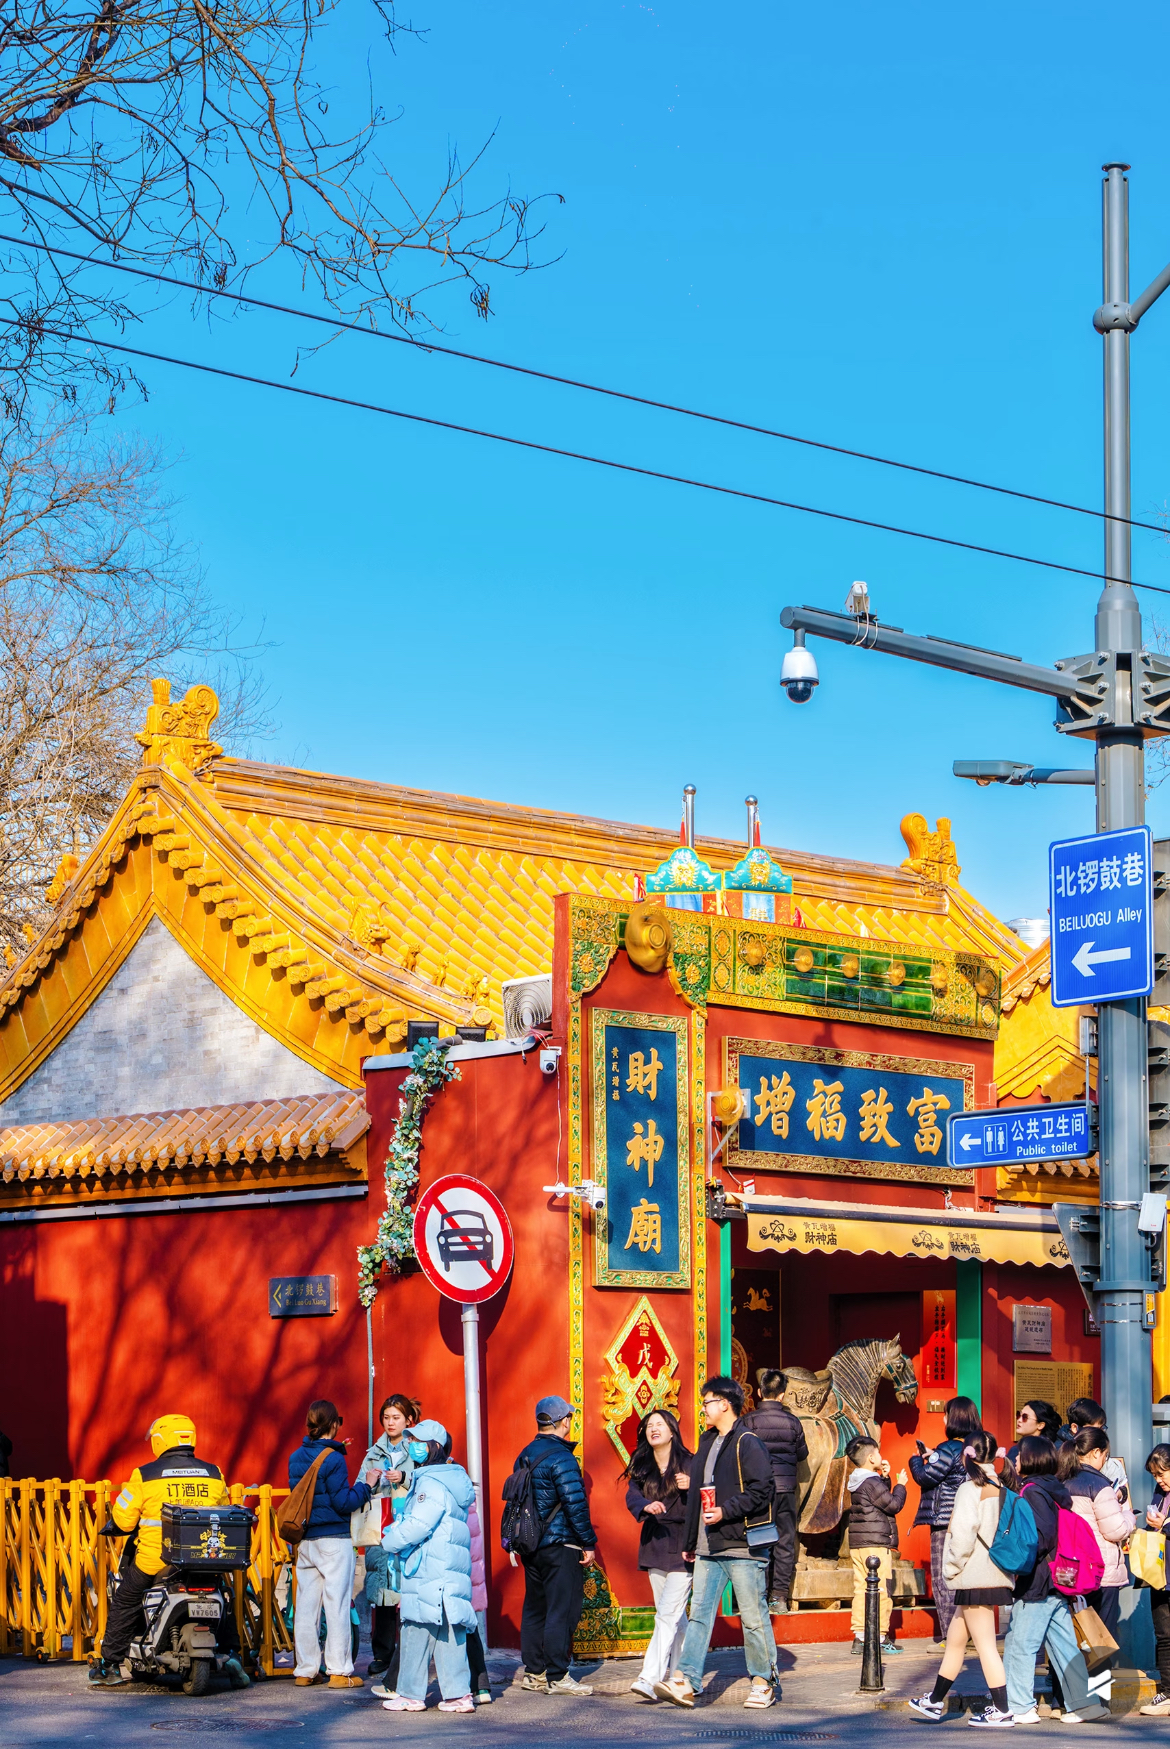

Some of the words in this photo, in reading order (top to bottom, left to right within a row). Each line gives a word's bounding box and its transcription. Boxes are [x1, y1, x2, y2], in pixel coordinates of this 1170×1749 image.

[1056, 852, 1144, 898] 北锣鼓巷
[1059, 910, 1111, 932] BEILUOGU
[1117, 907, 1142, 923] Alley
[754, 1070, 951, 1156] 增福致富
[1011, 1113, 1085, 1141] 公共卫生间
[624, 1047, 664, 1254] 財神廟
[1016, 1144, 1046, 1156] Public
[1051, 1142, 1078, 1153] toilet
[166, 1483, 209, 1498] 订酒店
